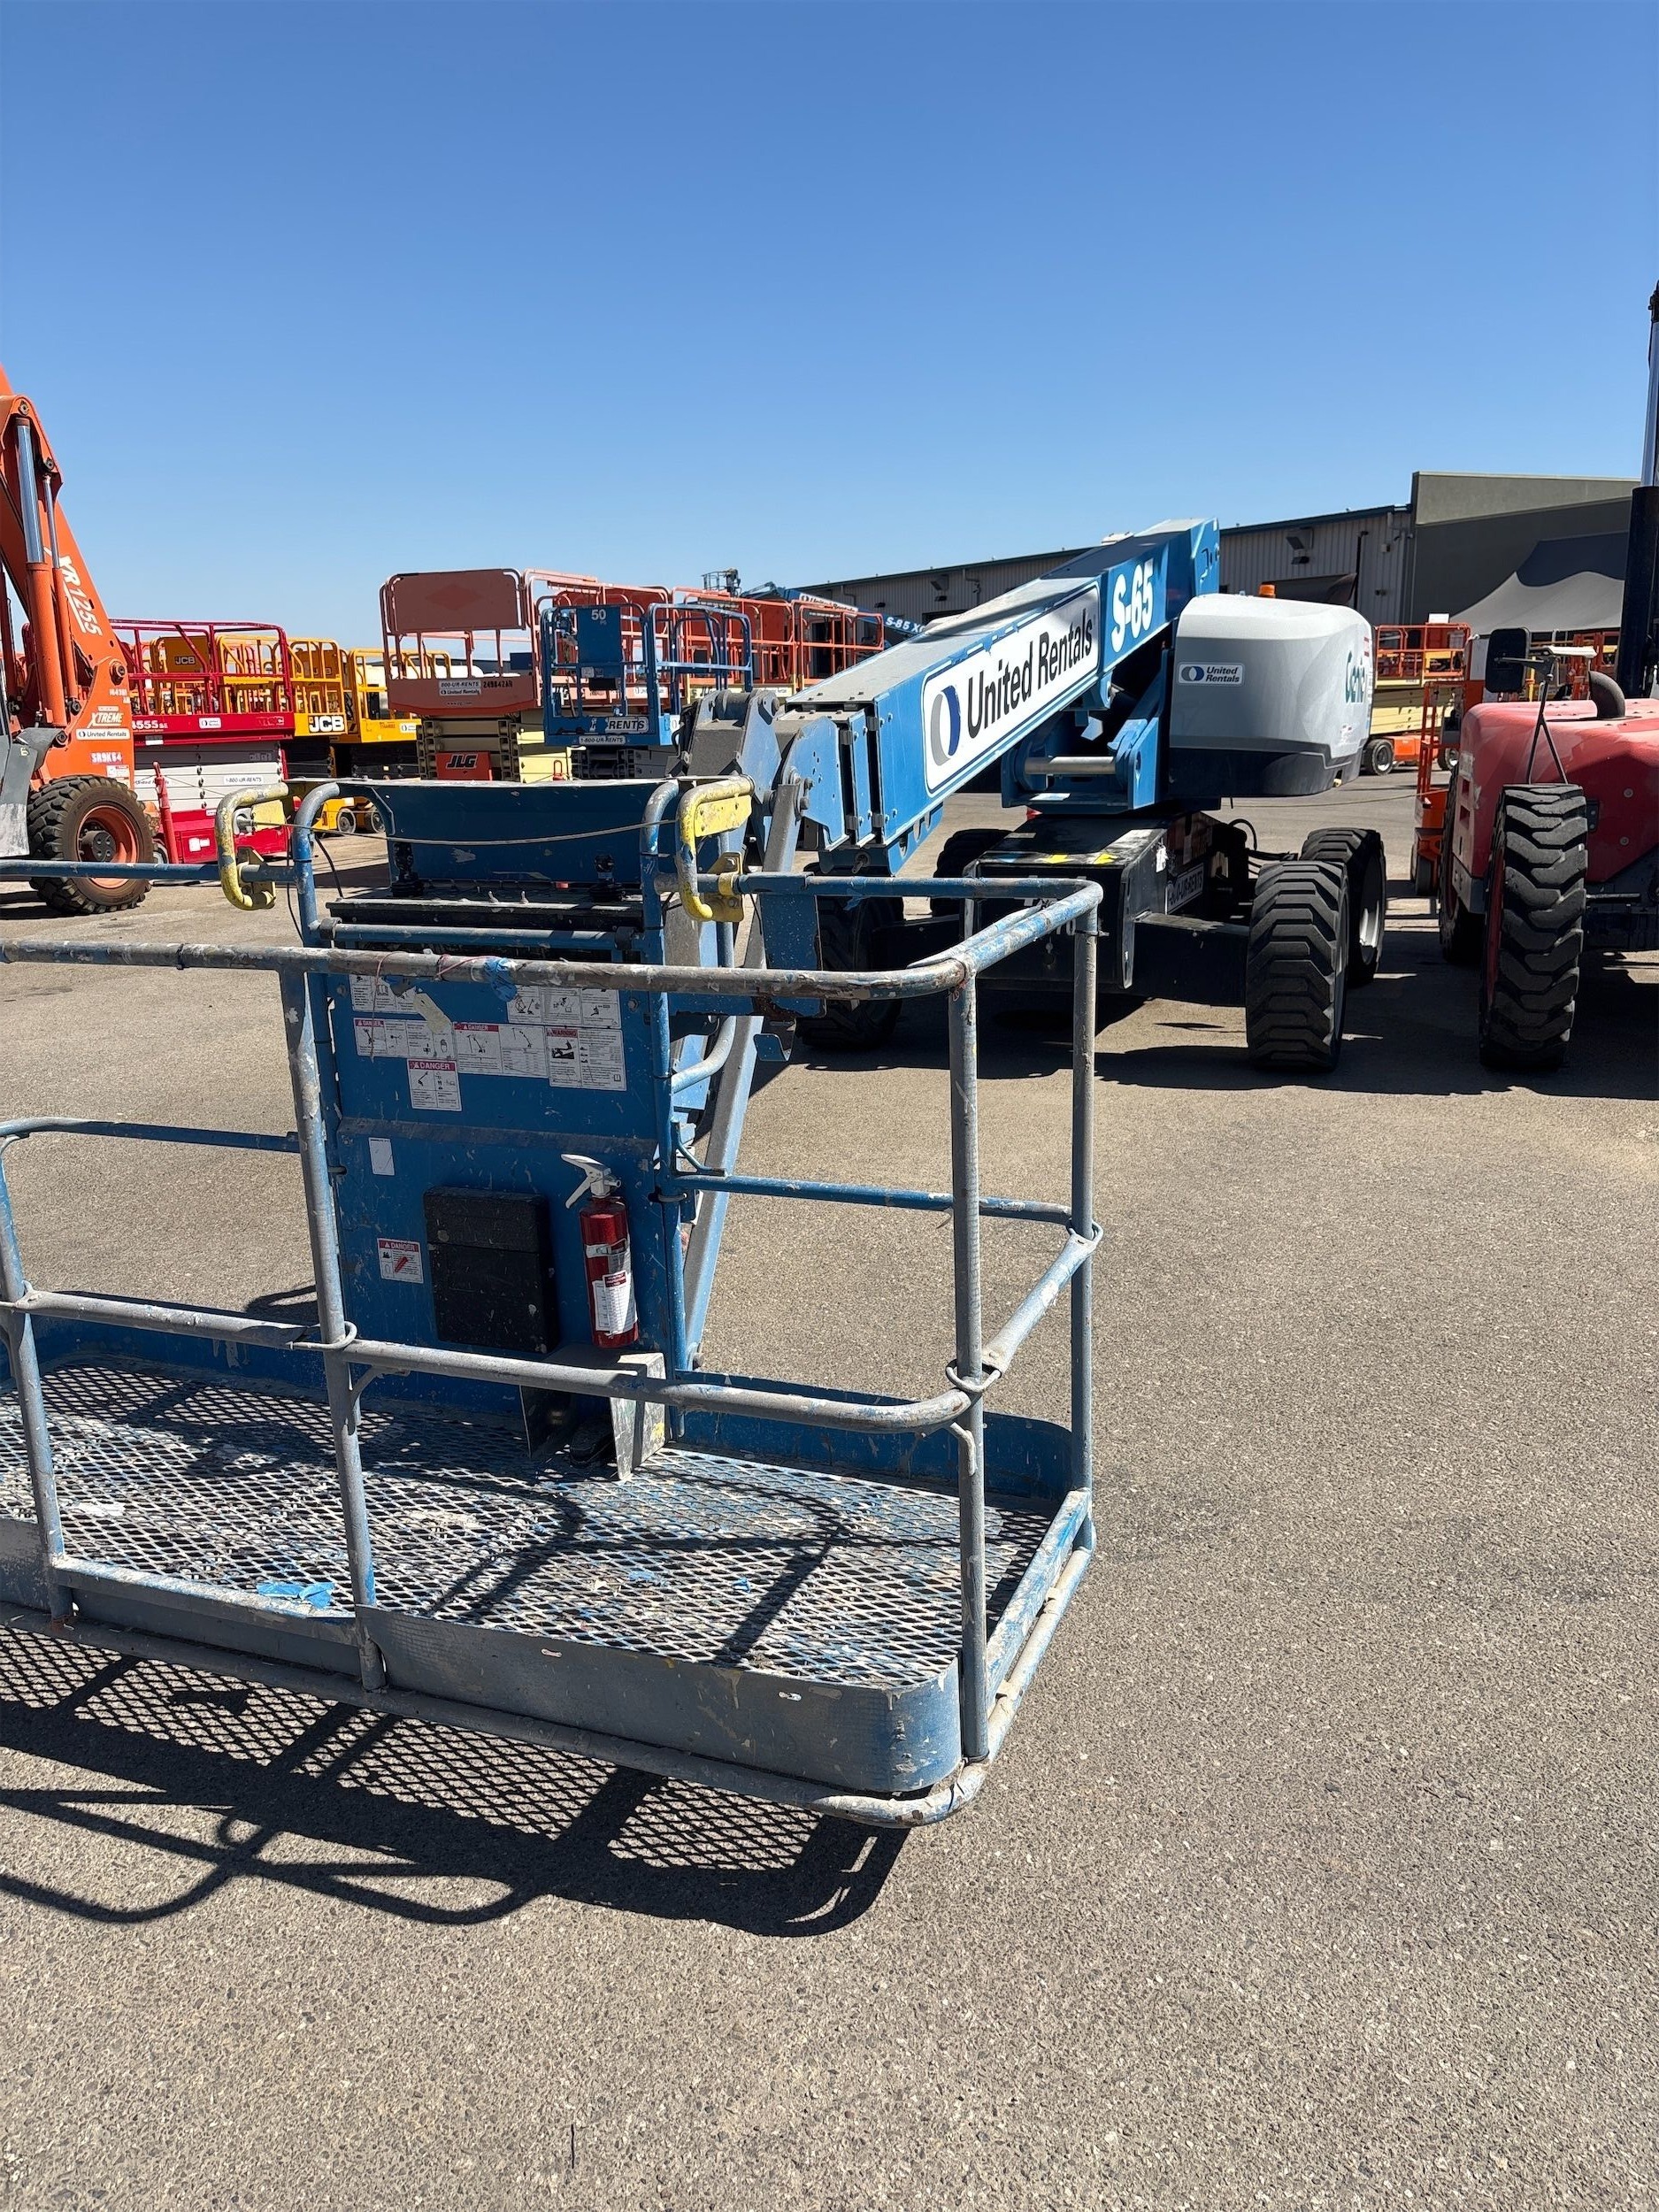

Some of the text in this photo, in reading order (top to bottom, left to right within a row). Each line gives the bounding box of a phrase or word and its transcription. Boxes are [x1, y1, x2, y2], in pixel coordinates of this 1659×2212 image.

[1111, 557, 1154, 653] S-65
[591, 609, 607, 620] 50
[886, 617, 910, 631] S-85
[967, 608, 1093, 738] United Rentals
[87, 711, 124, 728] XTREME
[309, 716, 345, 733] JCB
[446, 754, 478, 769] JLG
[419, 1062, 450, 1071] DANGER
[390, 1242, 416, 1252] DANGER
